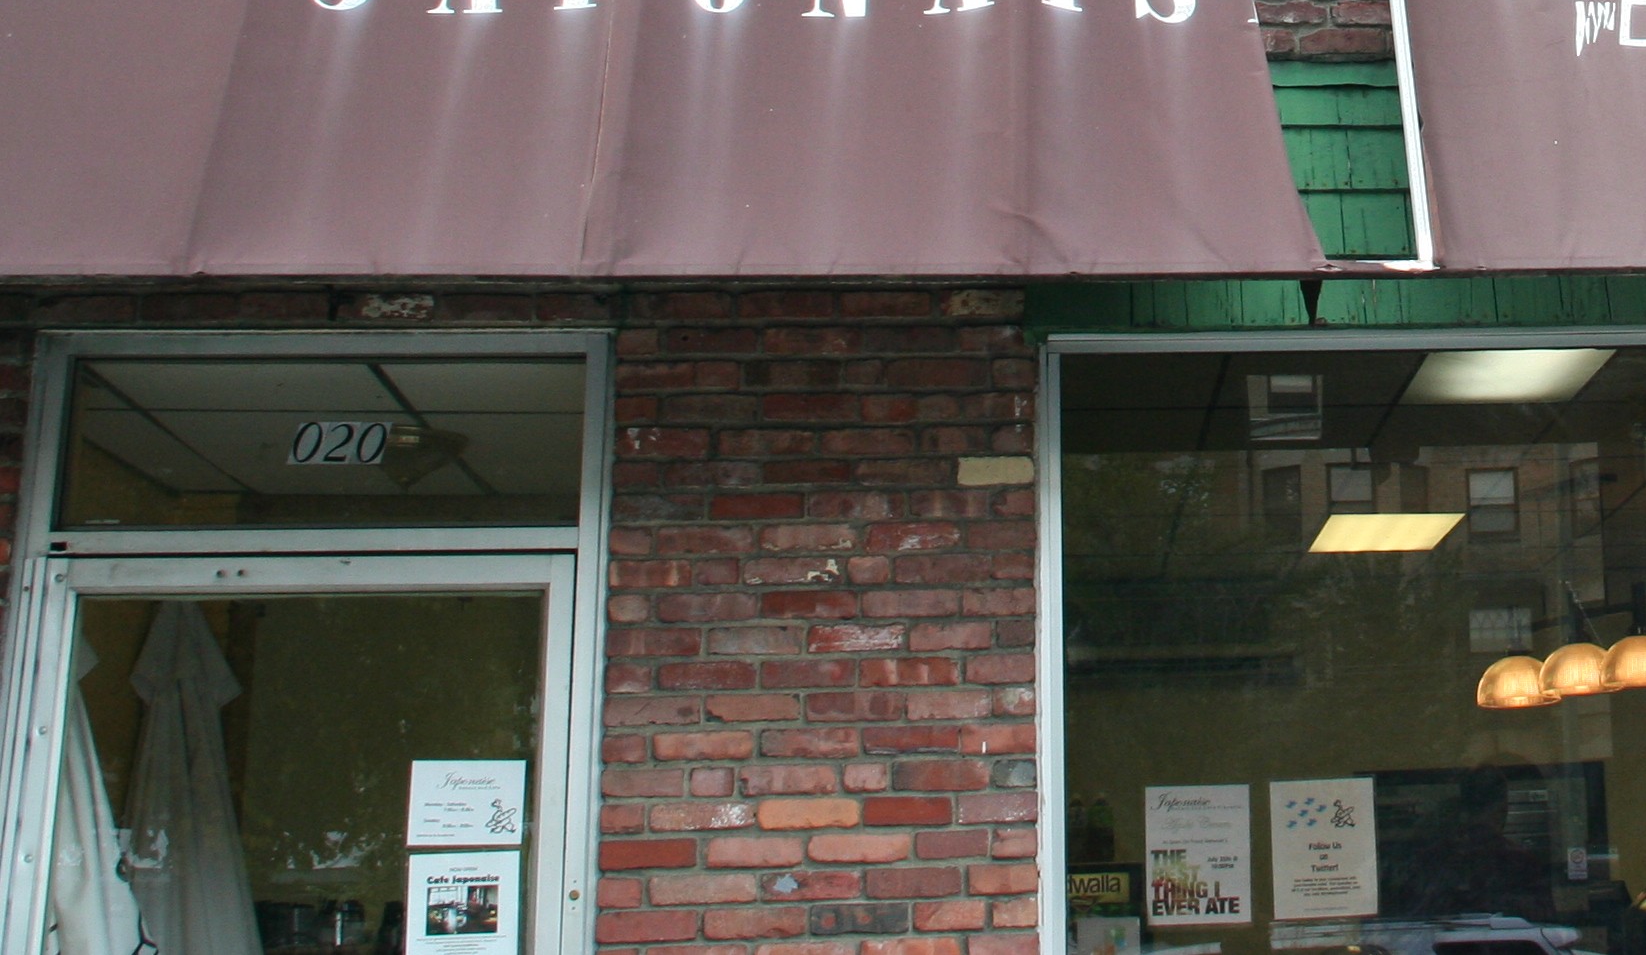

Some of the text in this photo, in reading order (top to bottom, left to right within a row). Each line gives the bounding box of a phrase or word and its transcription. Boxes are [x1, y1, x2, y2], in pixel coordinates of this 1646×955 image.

[293, 422, 387, 463] 020
[1151, 849, 1187, 865] THE
[426, 875, 449, 885] Cafe
[1152, 864, 1200, 881] BEST
[1152, 880, 1220, 900] THING I
[1152, 895, 1240, 916] EVER ATE
